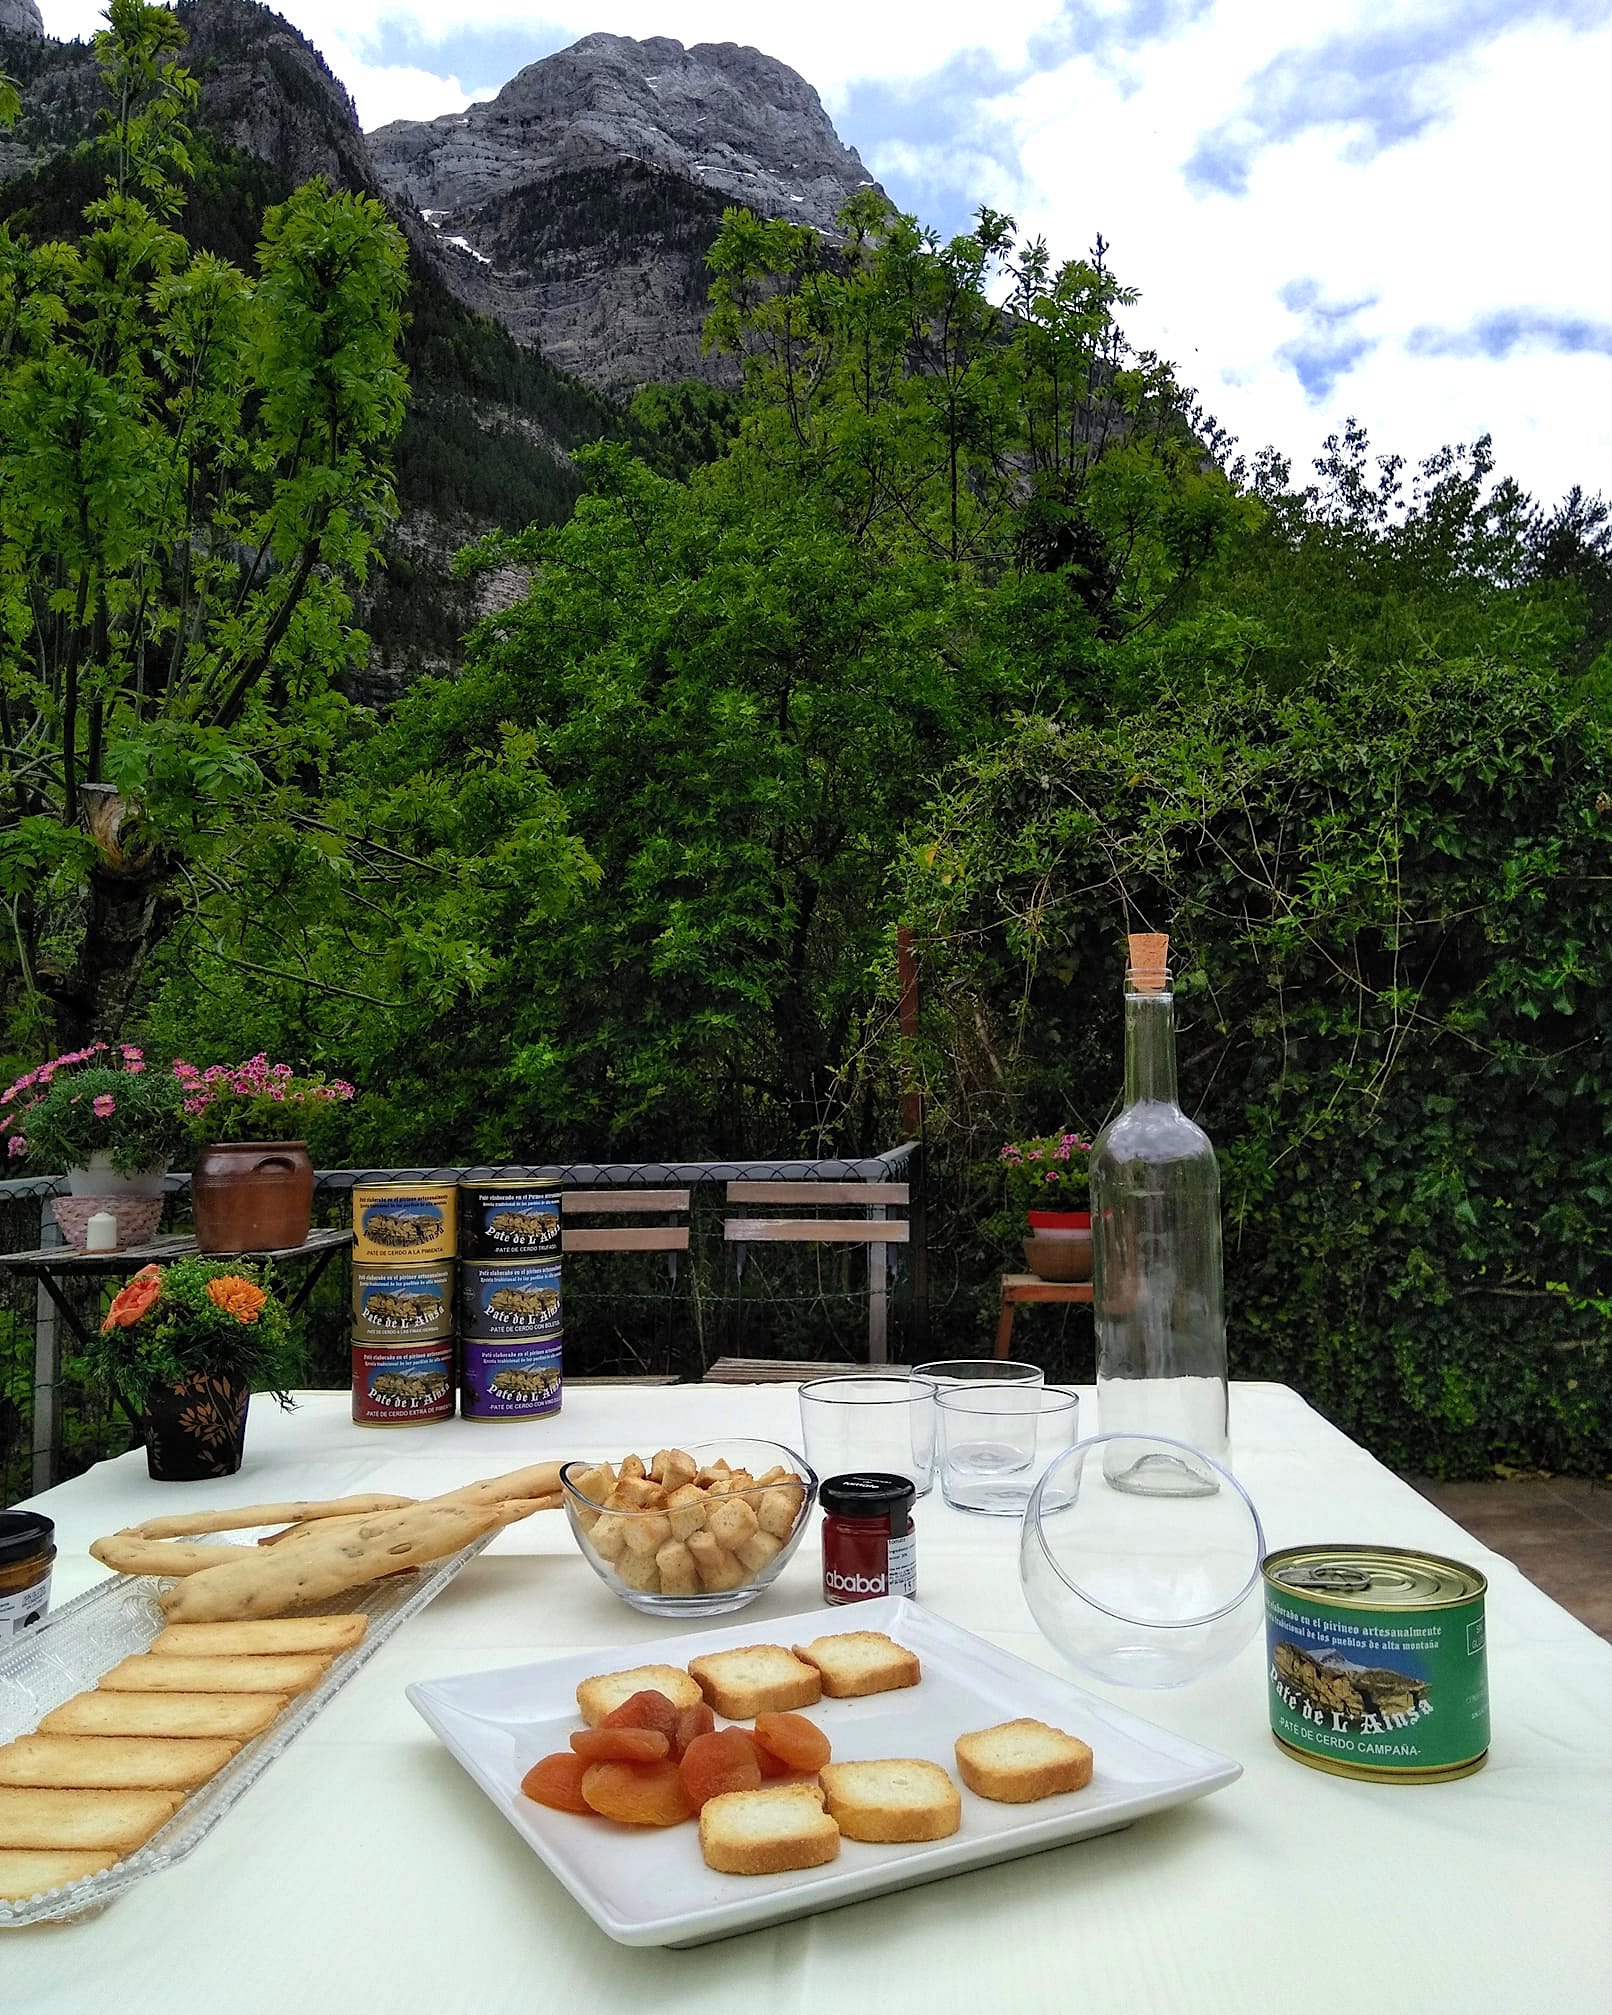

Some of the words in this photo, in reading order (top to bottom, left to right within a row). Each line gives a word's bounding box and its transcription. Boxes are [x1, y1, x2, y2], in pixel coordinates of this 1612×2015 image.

[513, 1233, 525, 1244] de
[386, 1317, 398, 1329] de
[512, 1314, 525, 1325] de
[368, 1388, 396, 1406] Paté
[394, 1398, 407, 1408] de
[487, 1384, 515, 1401] Paté
[516, 1392, 528, 1402] de
[826, 1570, 886, 1594] ababol
[1301, 1616, 1310, 1626] en
[1312, 1618, 1320, 1628] el
[1323, 1620, 1360, 1635] pirineo
[1362, 1626, 1442, 1638] artesanalmente
[1306, 1628, 1316, 1640] de
[1317, 1632, 1330, 1642] los
[1332, 1636, 1367, 1648] pueblos
[1369, 1640, 1380, 1650] de
[1382, 1641, 1400, 1650] alta
[1402, 1640, 1439, 1650] montaña
[1270, 1664, 1301, 1710] Paté
[1302, 1698, 1324, 1726] de
[1360, 1699, 1434, 1735] Ainsa
[1300, 1727, 1314, 1741] DE
[1315, 1733, 1355, 1750] CERDO
